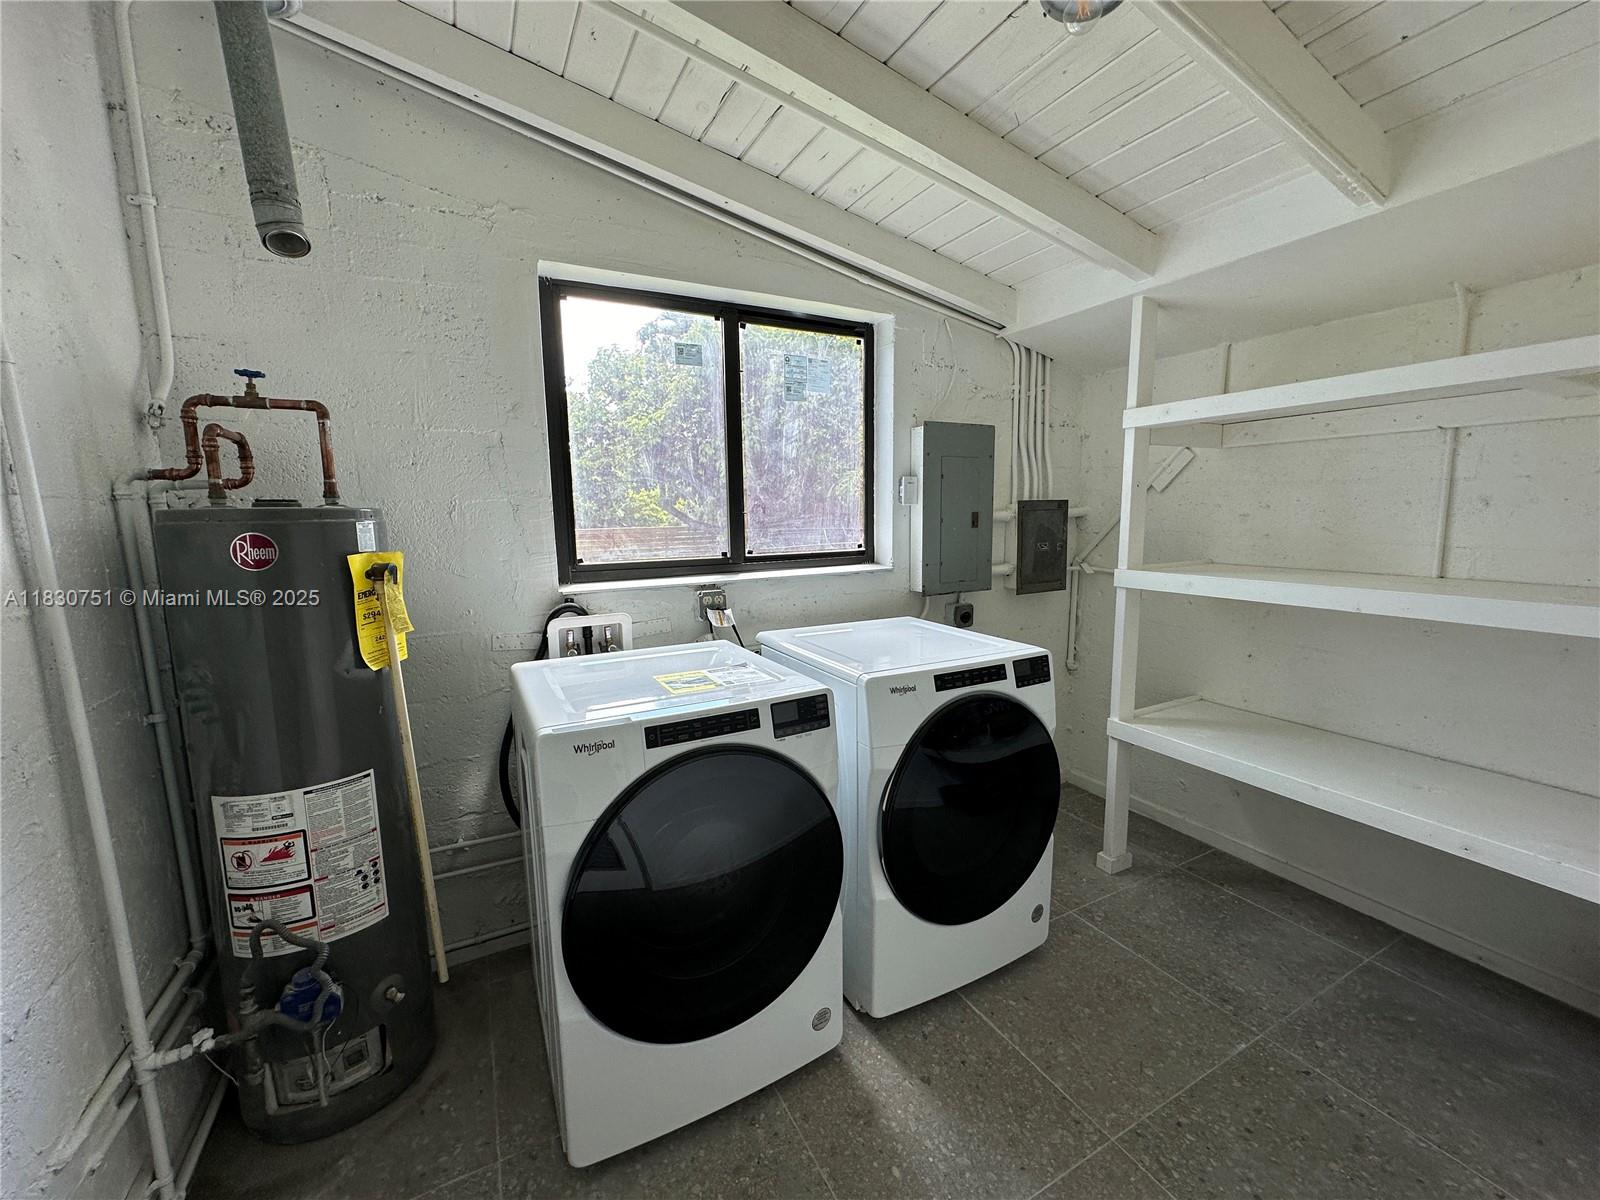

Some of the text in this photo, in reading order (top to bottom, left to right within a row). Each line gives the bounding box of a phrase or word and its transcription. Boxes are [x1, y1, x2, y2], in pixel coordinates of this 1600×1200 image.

[236, 534, 275, 565] Rheem
[889, 684, 917, 696] Whirlpool
[573, 739, 615, 756] Whirlpool
